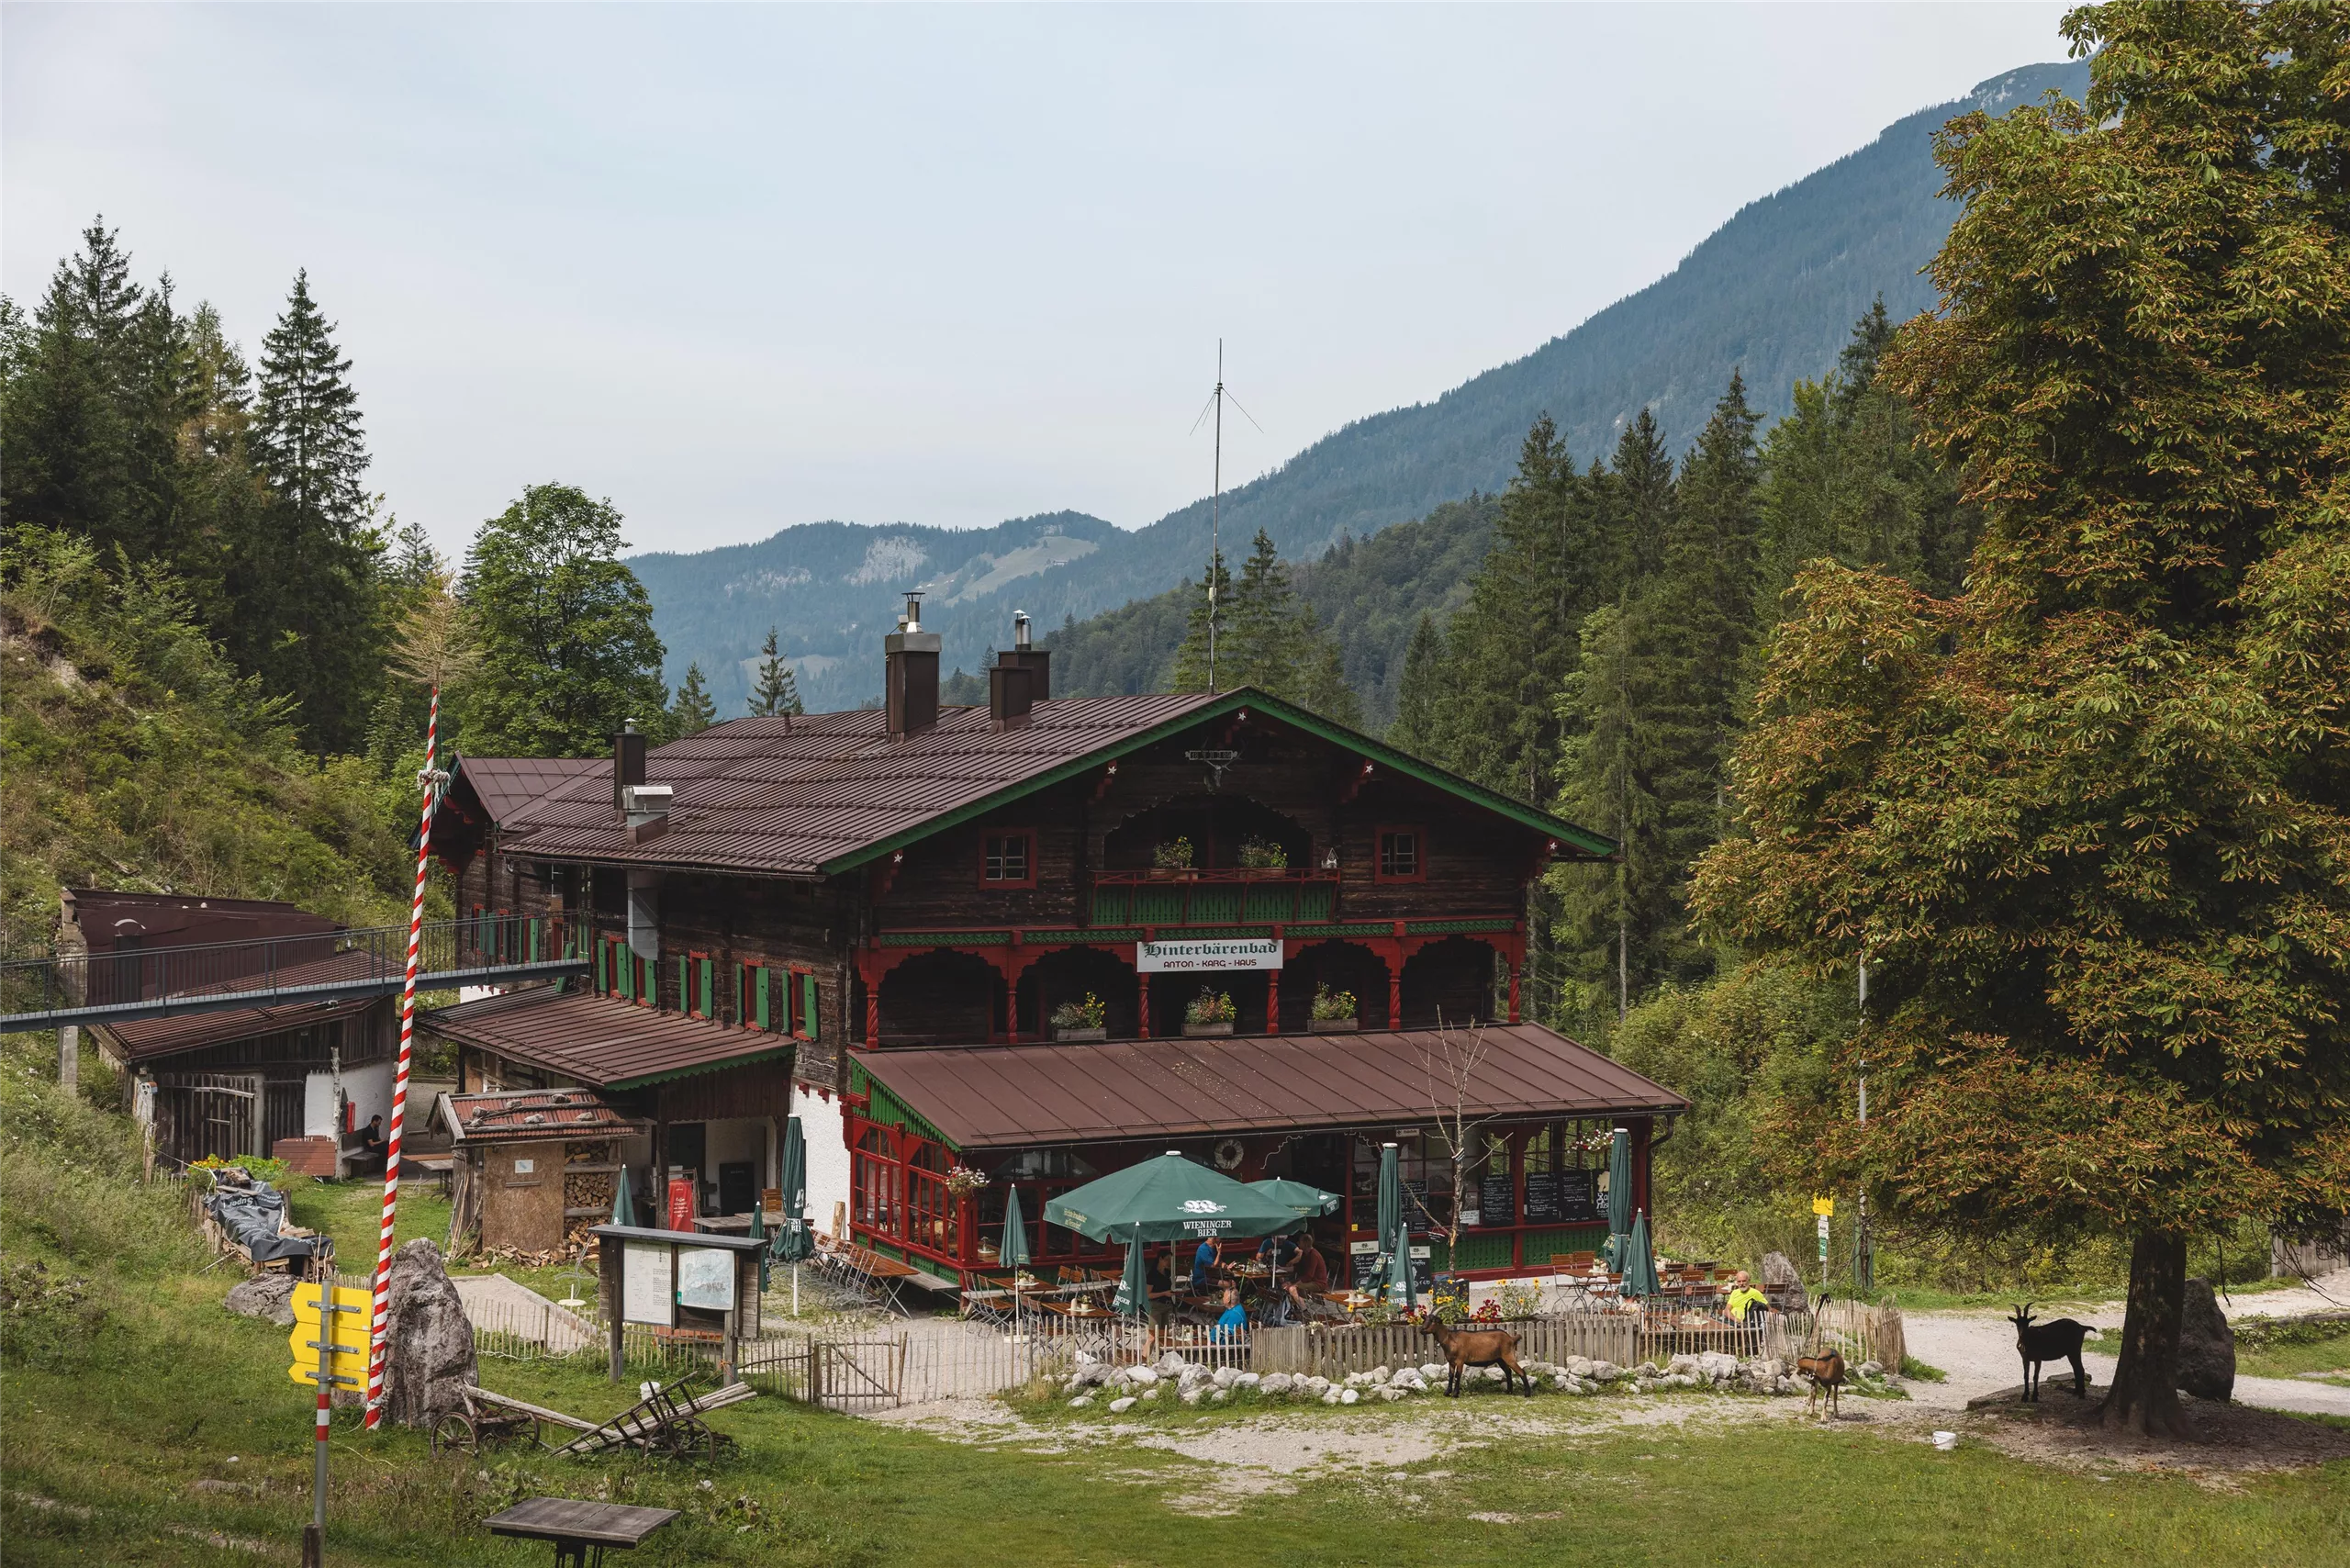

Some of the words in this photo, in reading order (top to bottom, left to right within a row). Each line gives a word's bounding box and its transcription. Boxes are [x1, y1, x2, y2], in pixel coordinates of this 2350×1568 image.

[1144, 943, 1277, 958] Hinterbärenbad
[1163, 960, 1194, 969] ANTON
[1202, 959, 1226, 968] KARG
[229, 1197, 253, 1206] Super
[1183, 1220, 1232, 1229] WIENINGER
[1197, 1229, 1217, 1238] BIER
